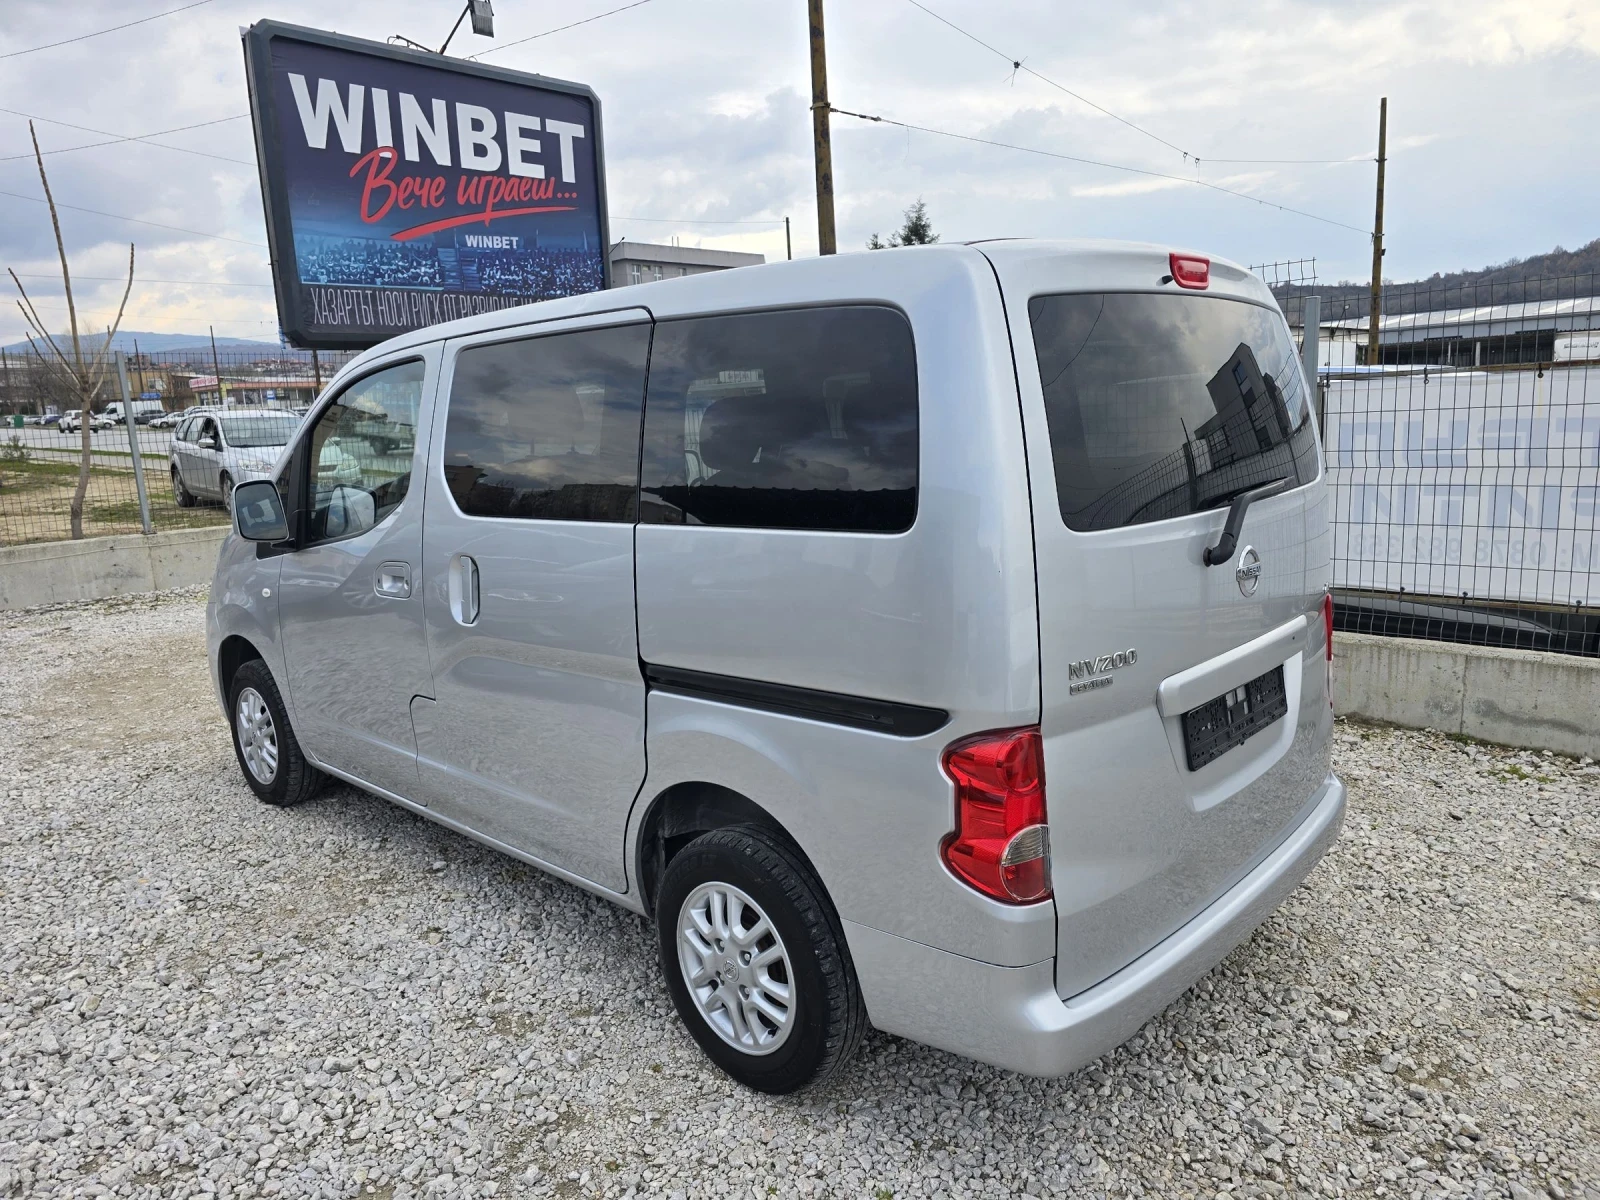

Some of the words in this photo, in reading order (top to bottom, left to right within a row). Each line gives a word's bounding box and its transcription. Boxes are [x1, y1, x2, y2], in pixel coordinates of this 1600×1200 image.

[288, 72, 585, 184] WINBET
[350, 146, 446, 224] Вече
[465, 235, 518, 250] WINBET
[310, 287, 374, 326] ХАЗАРТЪТ
[376, 290, 411, 327] НОСИ
[413, 292, 442, 328] РИСК
[1068, 648, 1137, 681] NV200
